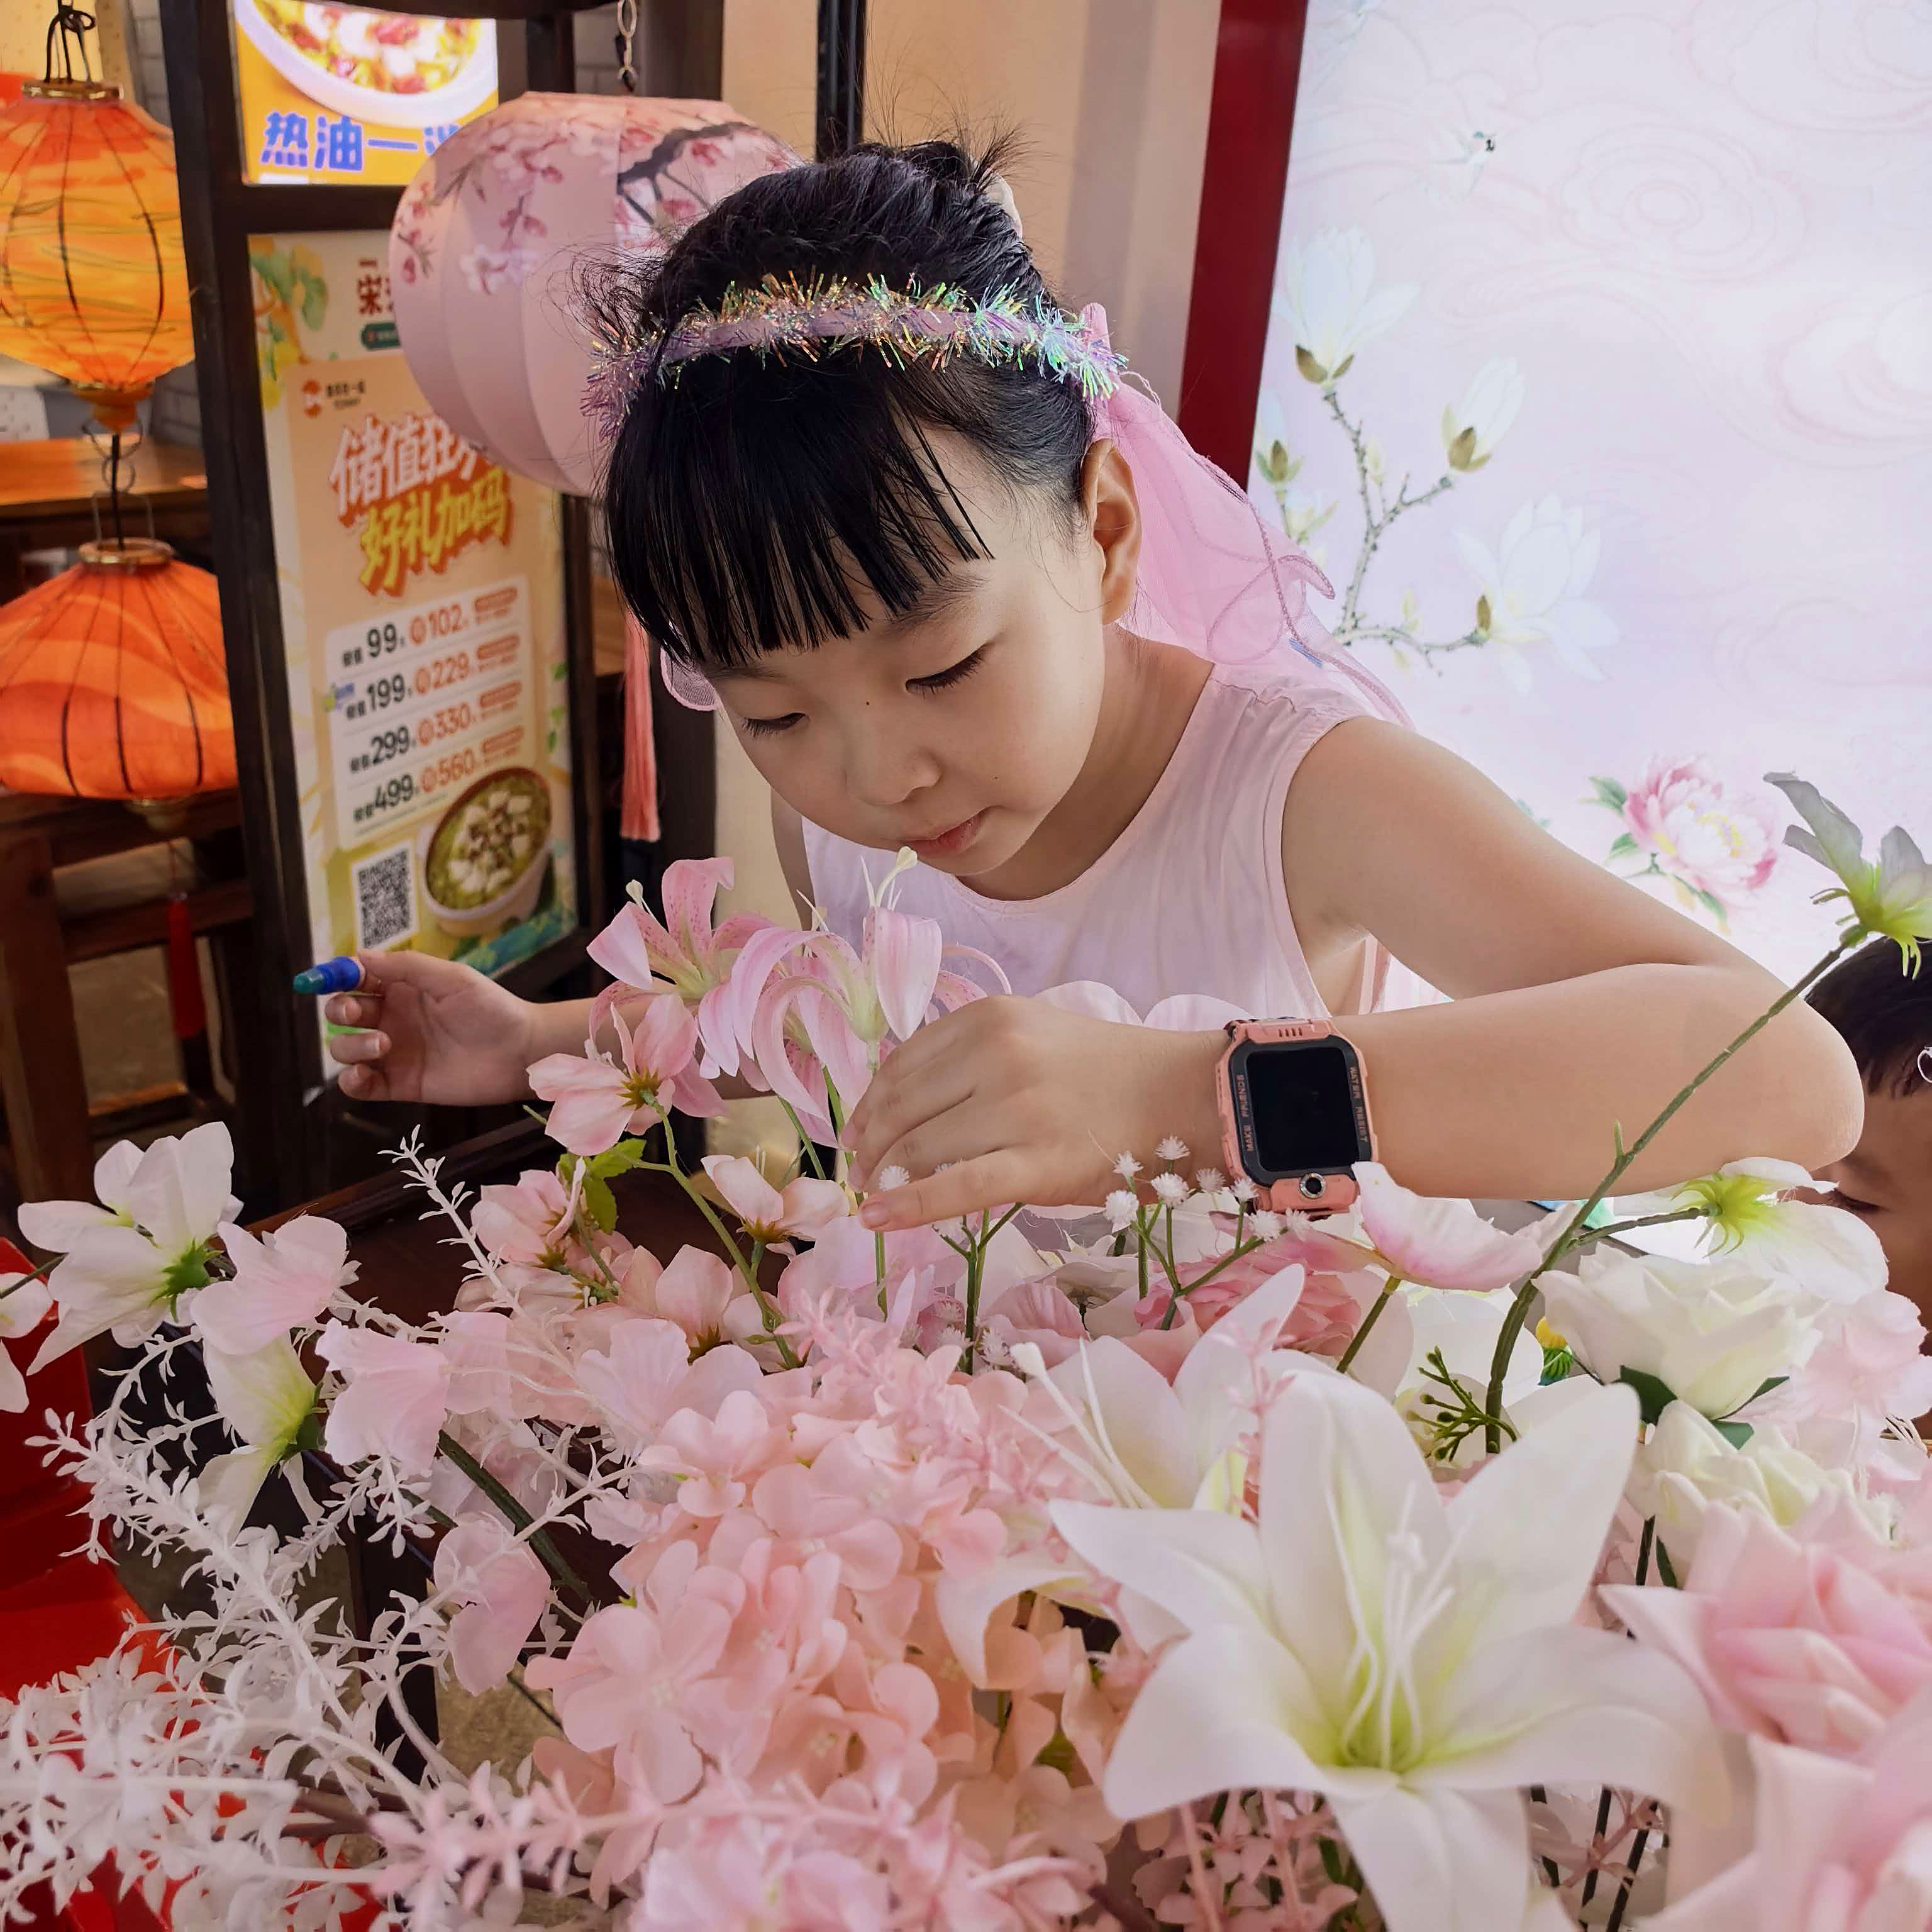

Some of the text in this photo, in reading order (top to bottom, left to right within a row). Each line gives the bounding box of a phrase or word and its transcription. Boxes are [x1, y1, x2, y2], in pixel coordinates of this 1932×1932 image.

[359, 465, 507, 590] 好礼加码
[367, 623, 397, 658] 99
[428, 603, 463, 638] 102
[367, 674, 406, 711] 199
[433, 652, 469, 689] 229
[370, 726, 410, 765] 299
[374, 774, 414, 810] 499
[1349, 1067, 1360, 1099] WATER
[1242, 1124, 1253, 1152] MAKE
